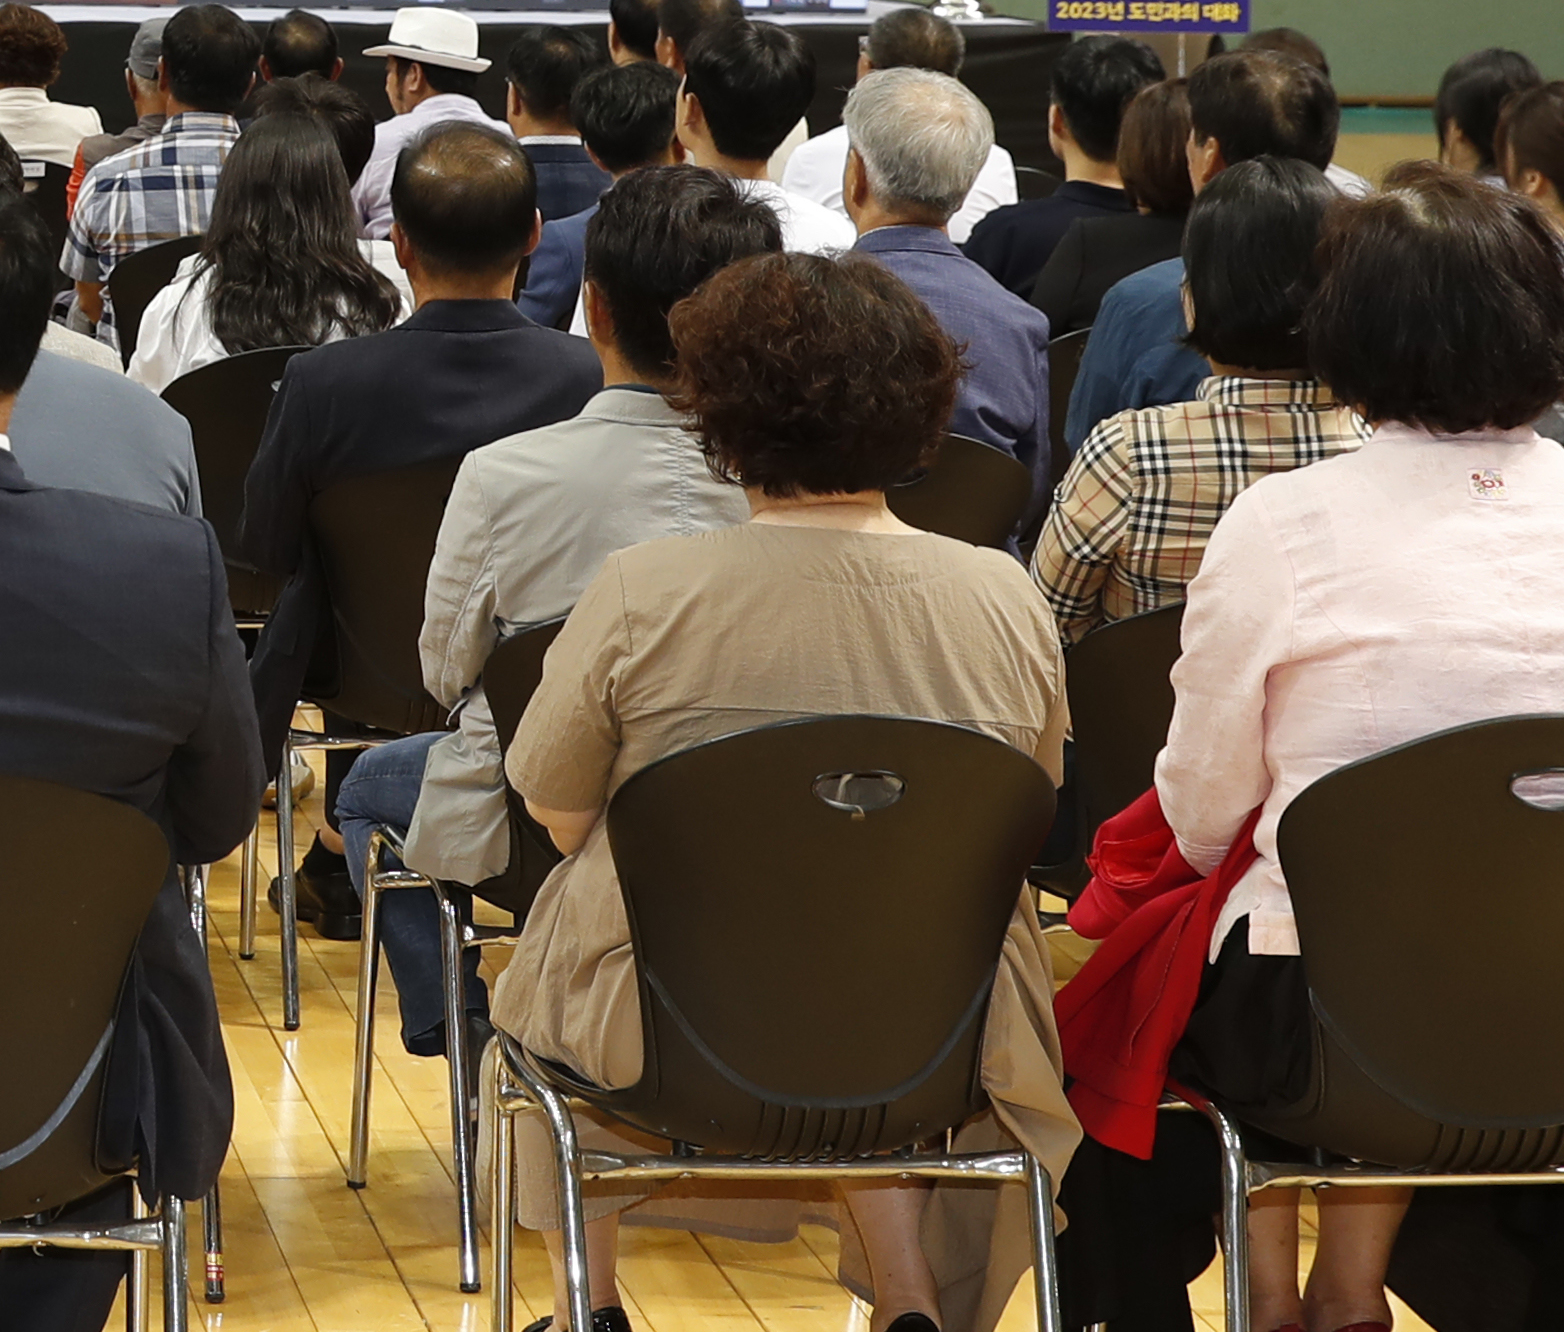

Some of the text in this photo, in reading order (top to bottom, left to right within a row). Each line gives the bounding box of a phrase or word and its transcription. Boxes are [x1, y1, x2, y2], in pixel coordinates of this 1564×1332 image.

[1055, 1, 1242, 23] 2023년 도민과의 대화
